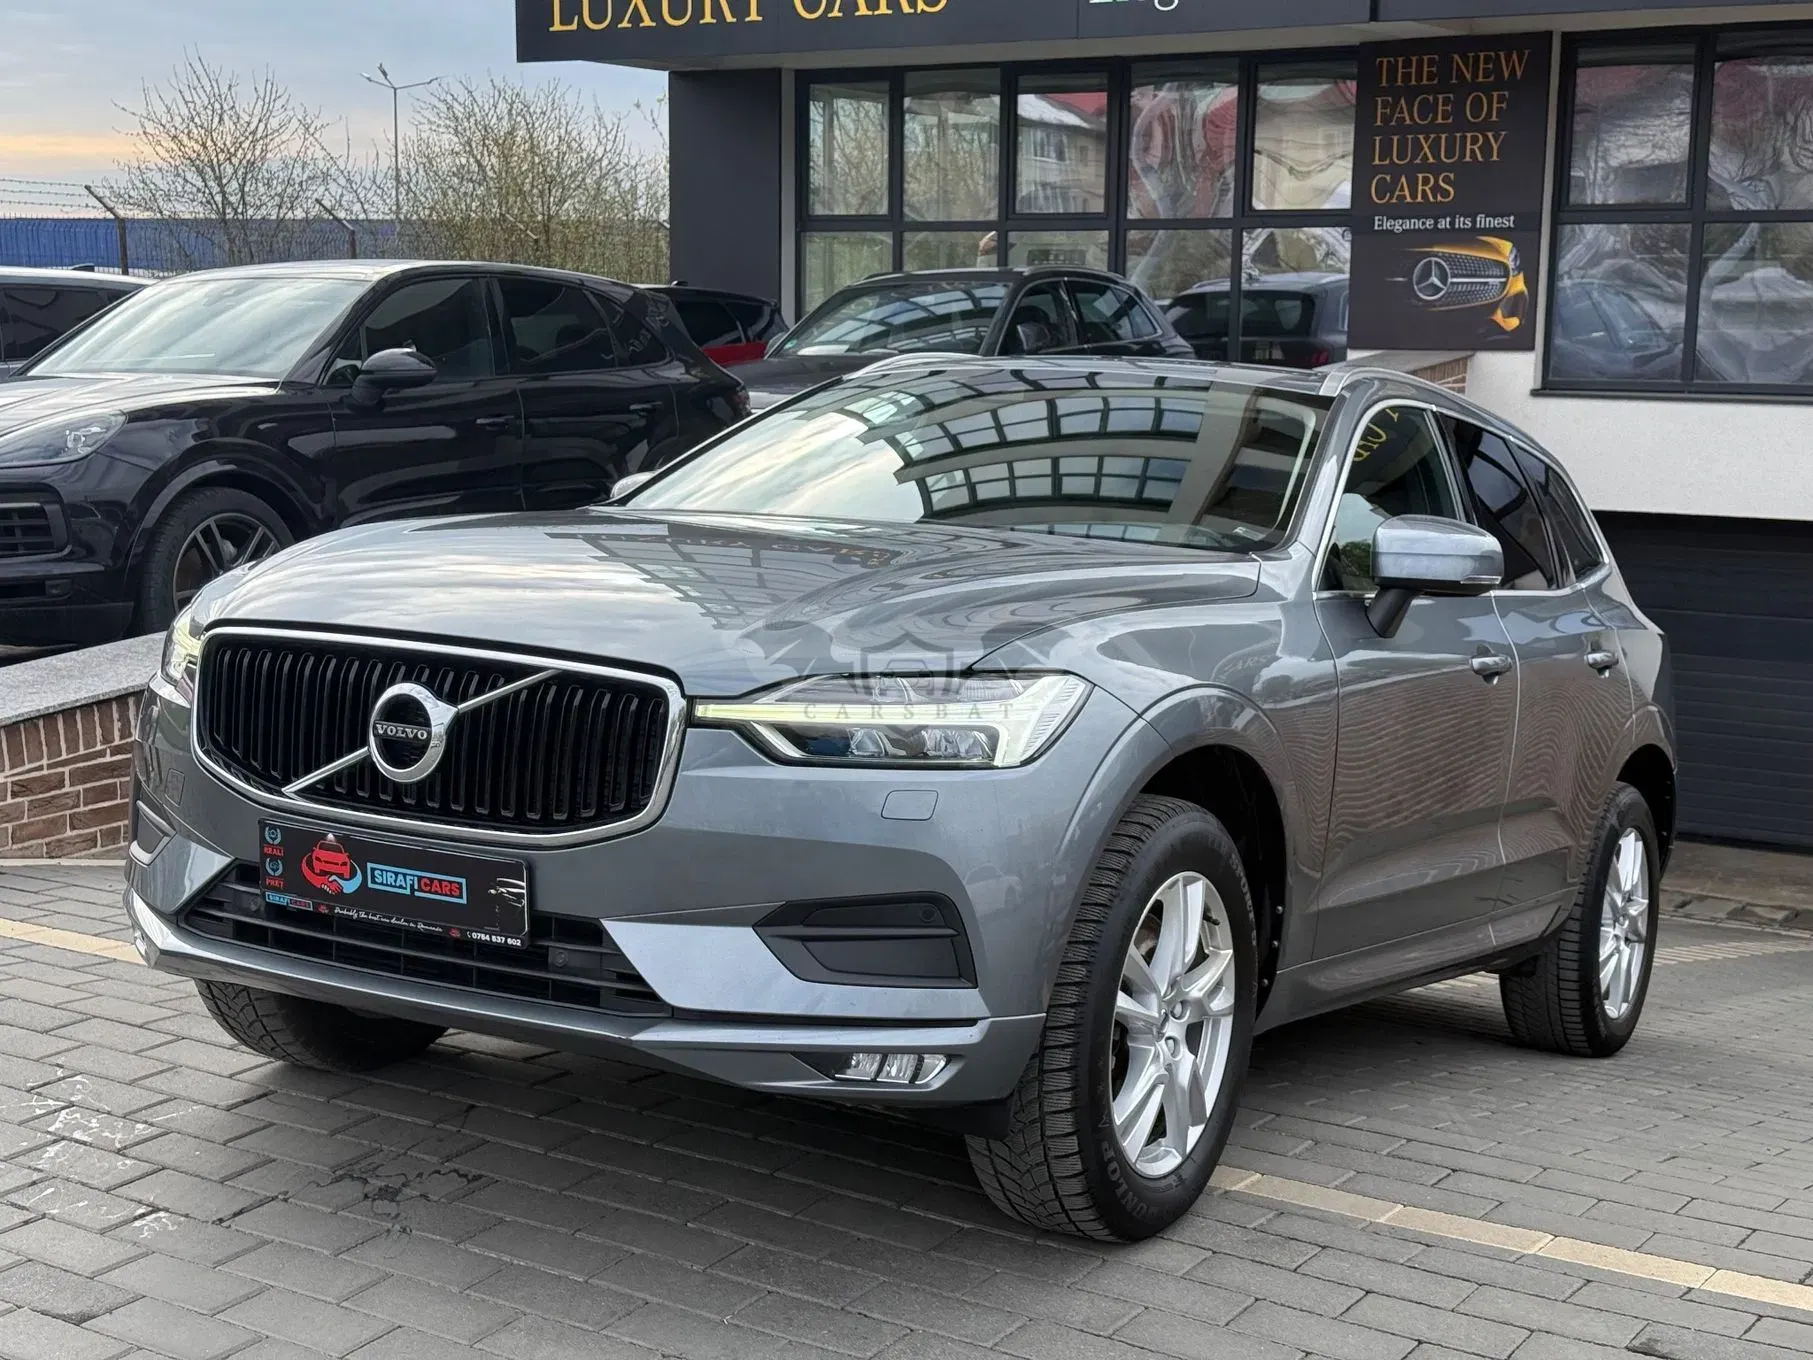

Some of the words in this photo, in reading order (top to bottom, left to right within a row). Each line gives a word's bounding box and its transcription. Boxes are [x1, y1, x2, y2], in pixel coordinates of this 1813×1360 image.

[1376, 55, 1438, 87] THE
[1450, 51, 1530, 83] NEW
[1373, 93, 1453, 126] FACE
[1465, 91, 1509, 122] OF
[1372, 131, 1507, 164] LUXURY
[1370, 172, 1456, 204] CARS
[1374, 216, 1435, 233] Elegance
[1437, 216, 1451, 229] at
[1455, 215, 1472, 229] its
[1476, 214, 1515, 229] finest
[375, 723, 428, 740] VOLVO
[374, 869, 418, 892] SIRAFI
[420, 877, 461, 897] CARS
